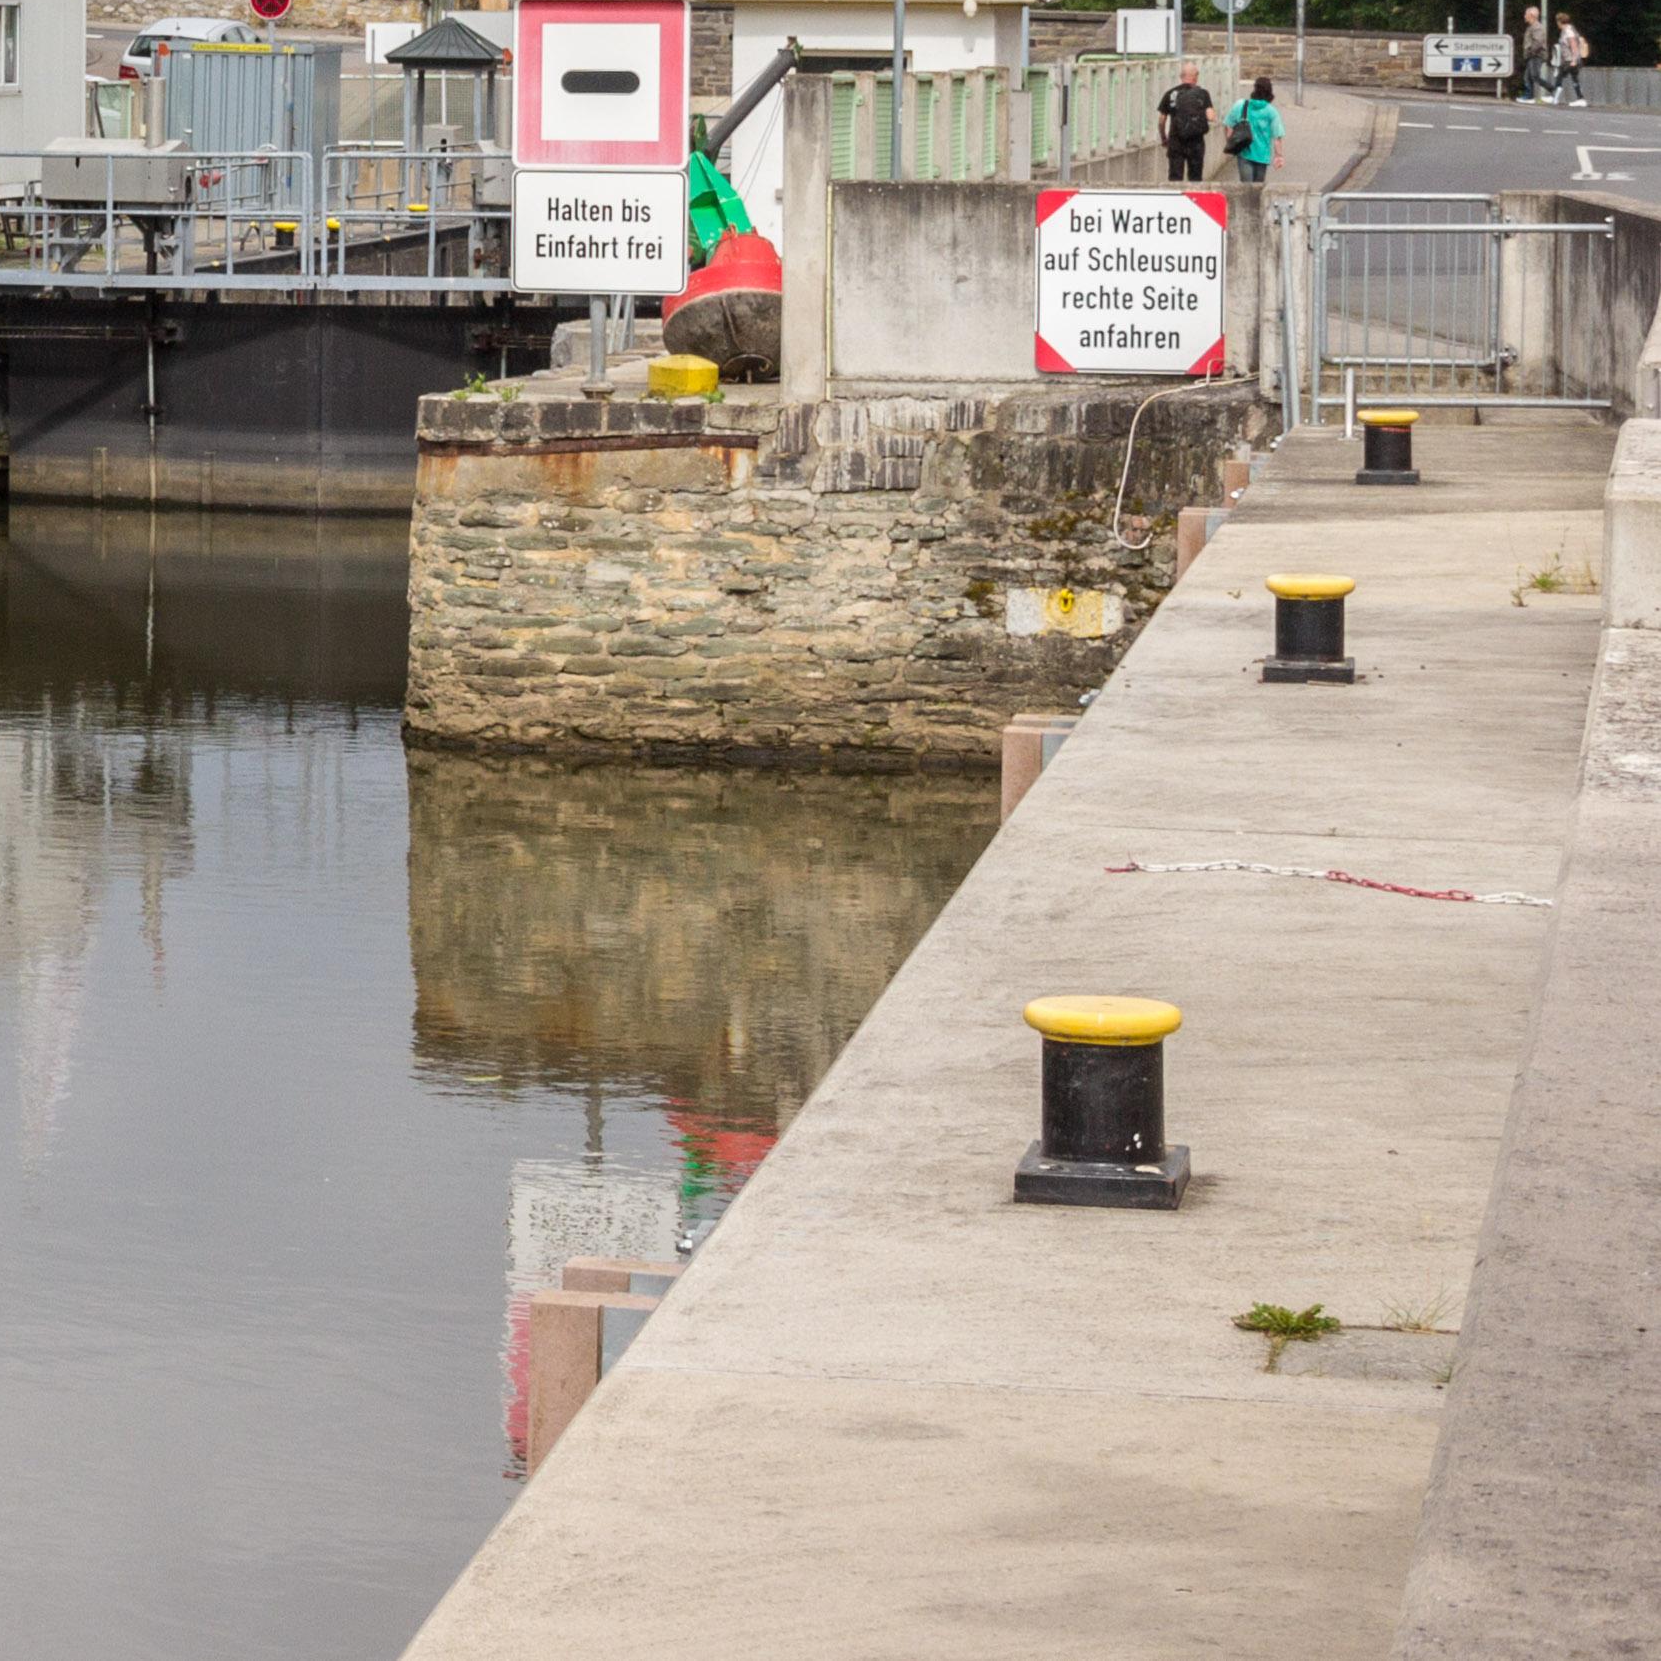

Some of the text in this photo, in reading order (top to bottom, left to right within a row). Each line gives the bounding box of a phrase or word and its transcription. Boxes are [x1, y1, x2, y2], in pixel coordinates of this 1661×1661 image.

[1454, 42, 1504, 51] Stadtmitte
[547, 197, 651, 222] Halten bis
[1070, 208, 1191, 234] bei Warten
[535, 234, 662, 260] Einfahrt frei
[1044, 247, 1217, 280] auf Schleusung
[1062, 285, 1198, 311] rechte Seite
[1079, 323, 1180, 349] anfahren
